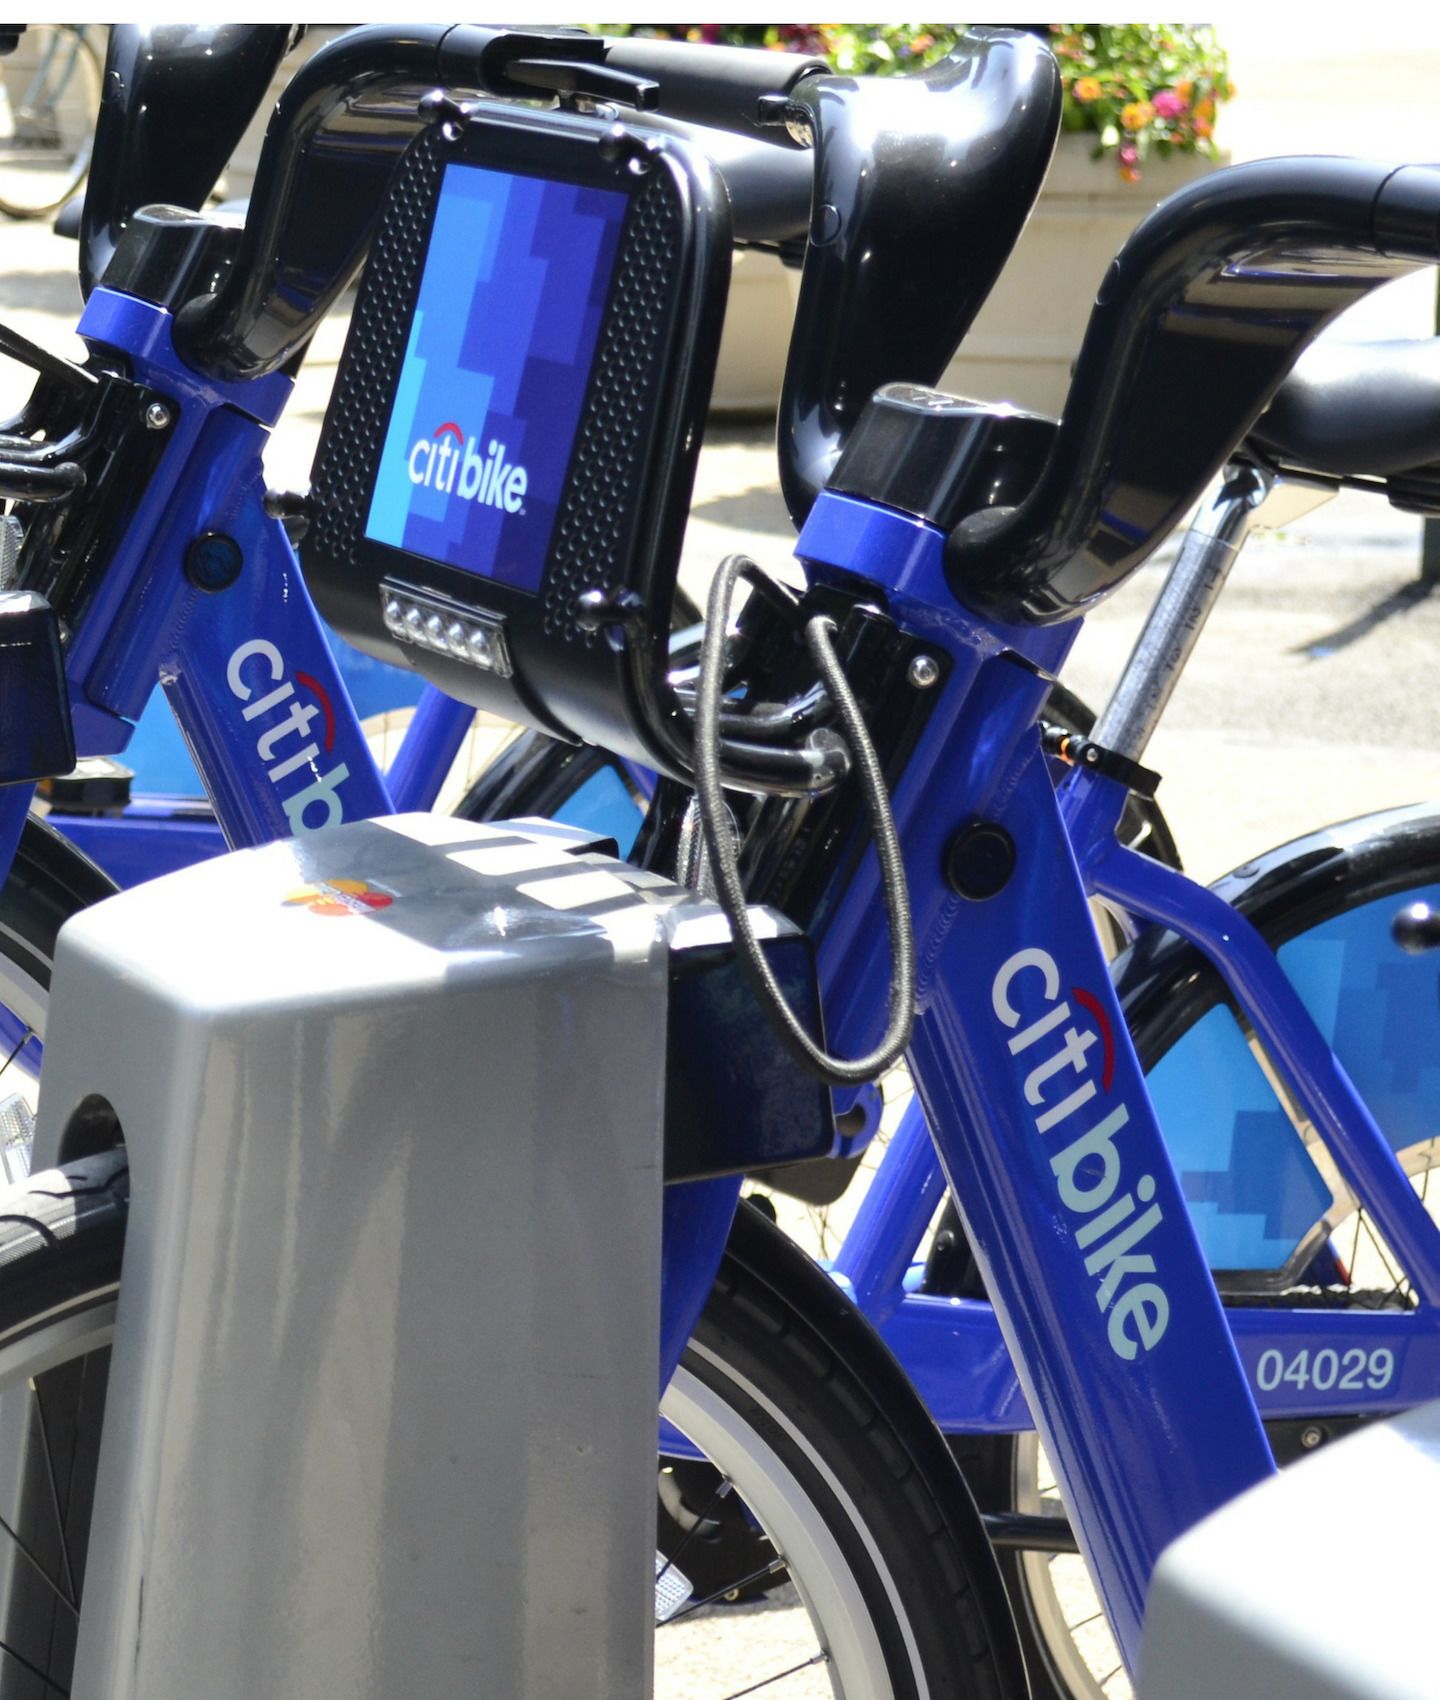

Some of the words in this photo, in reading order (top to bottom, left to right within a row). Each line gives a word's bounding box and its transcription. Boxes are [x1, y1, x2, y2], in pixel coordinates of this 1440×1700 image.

[408, 422, 464, 494] citi
[456, 436, 527, 513] bike
[992, 948, 1113, 1134] citi
[1049, 1103, 1170, 1361] bike
[1255, 1348, 1395, 1391] 04029
